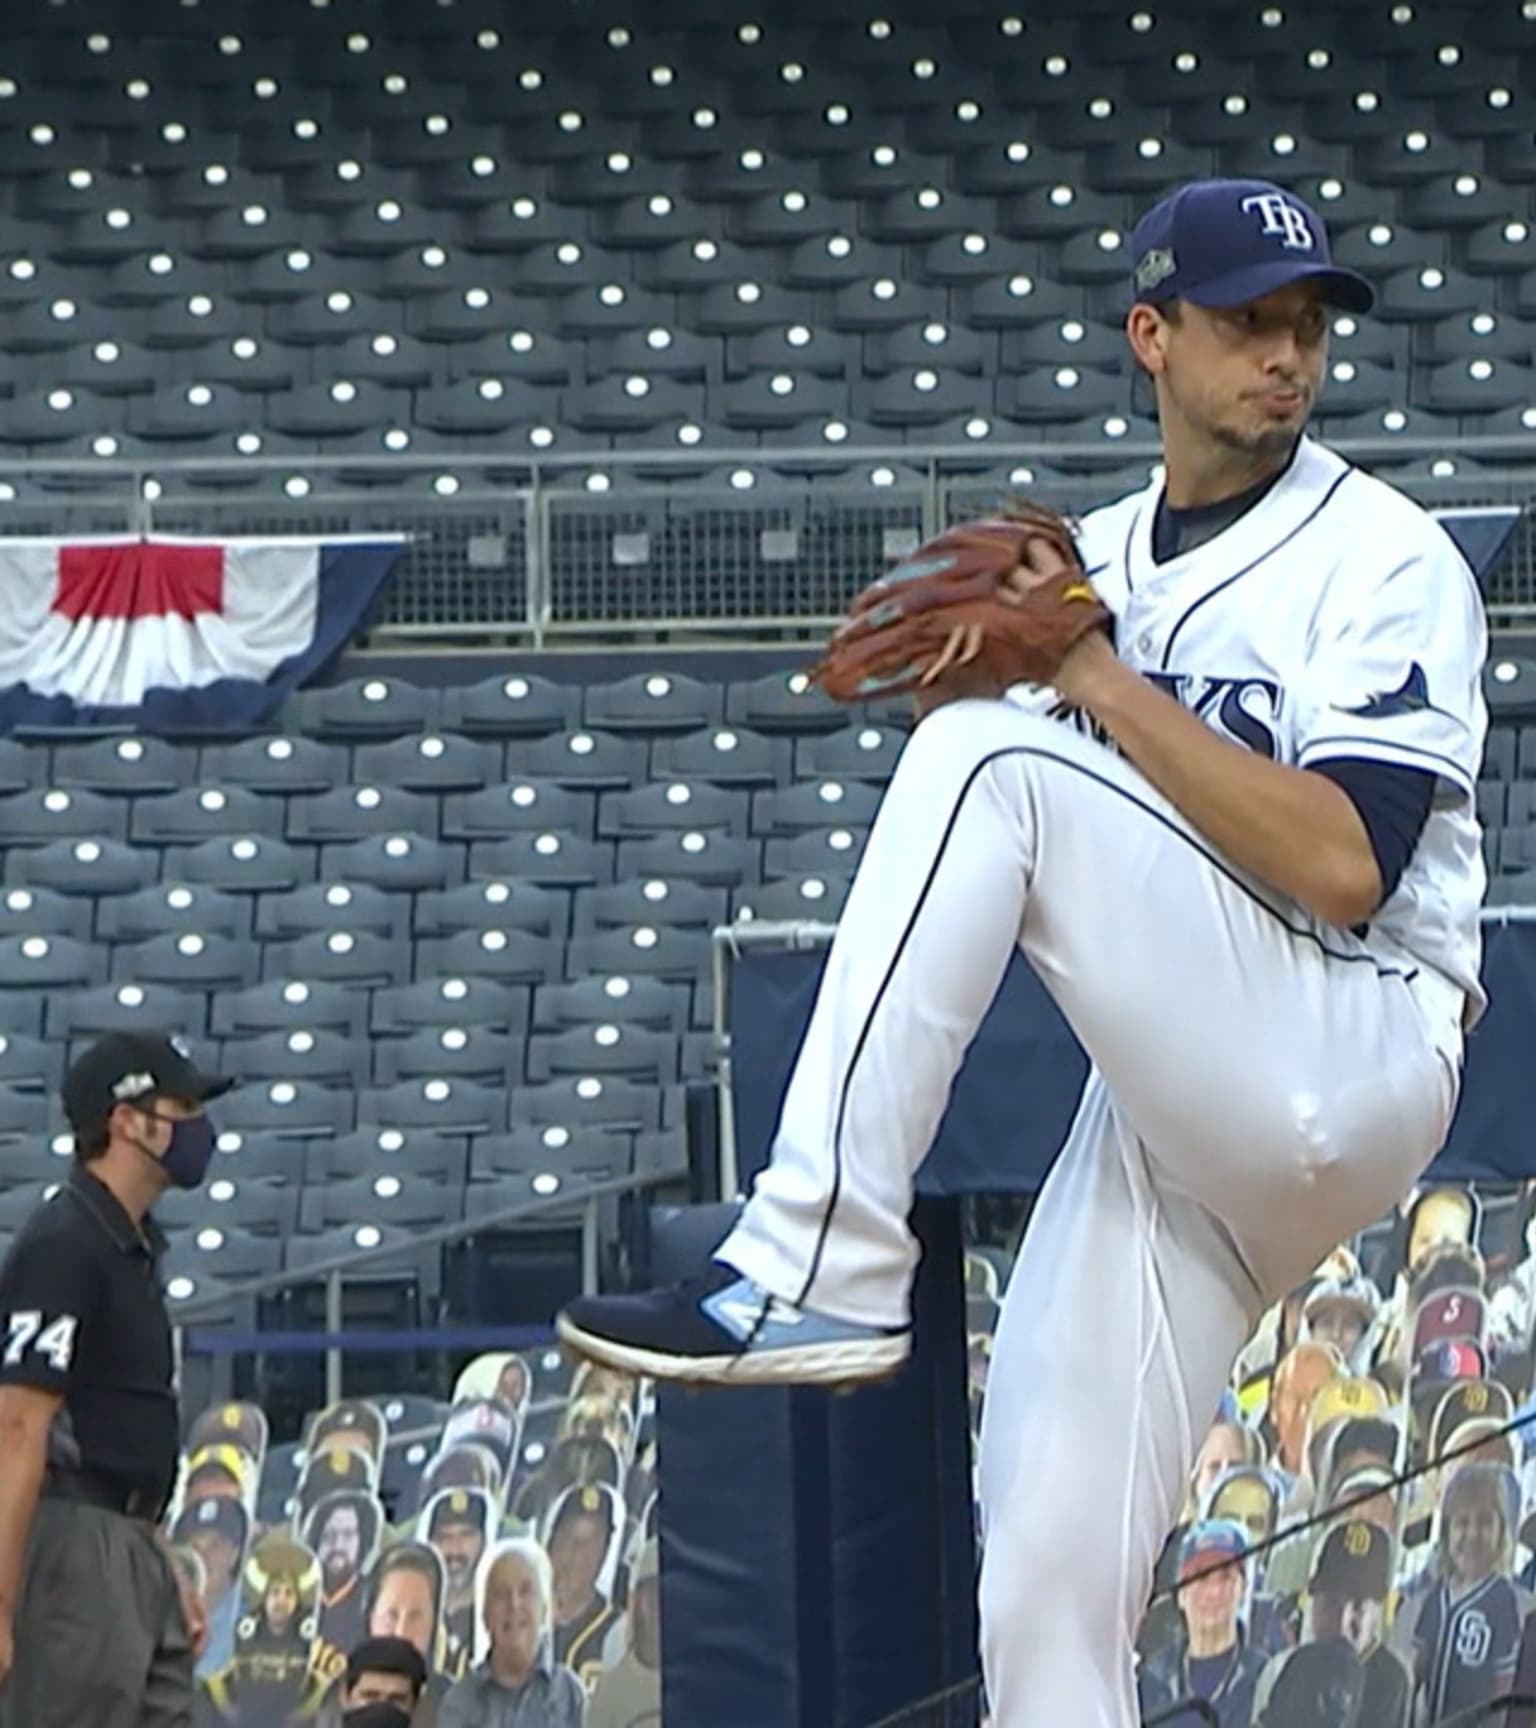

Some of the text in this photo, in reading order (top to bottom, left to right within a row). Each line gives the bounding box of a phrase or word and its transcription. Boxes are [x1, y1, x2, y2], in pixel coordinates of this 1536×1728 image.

[1242, 193, 1313, 251] TB
[4, 1309, 79, 1371] 74
[1456, 1610, 1492, 1666] SD
